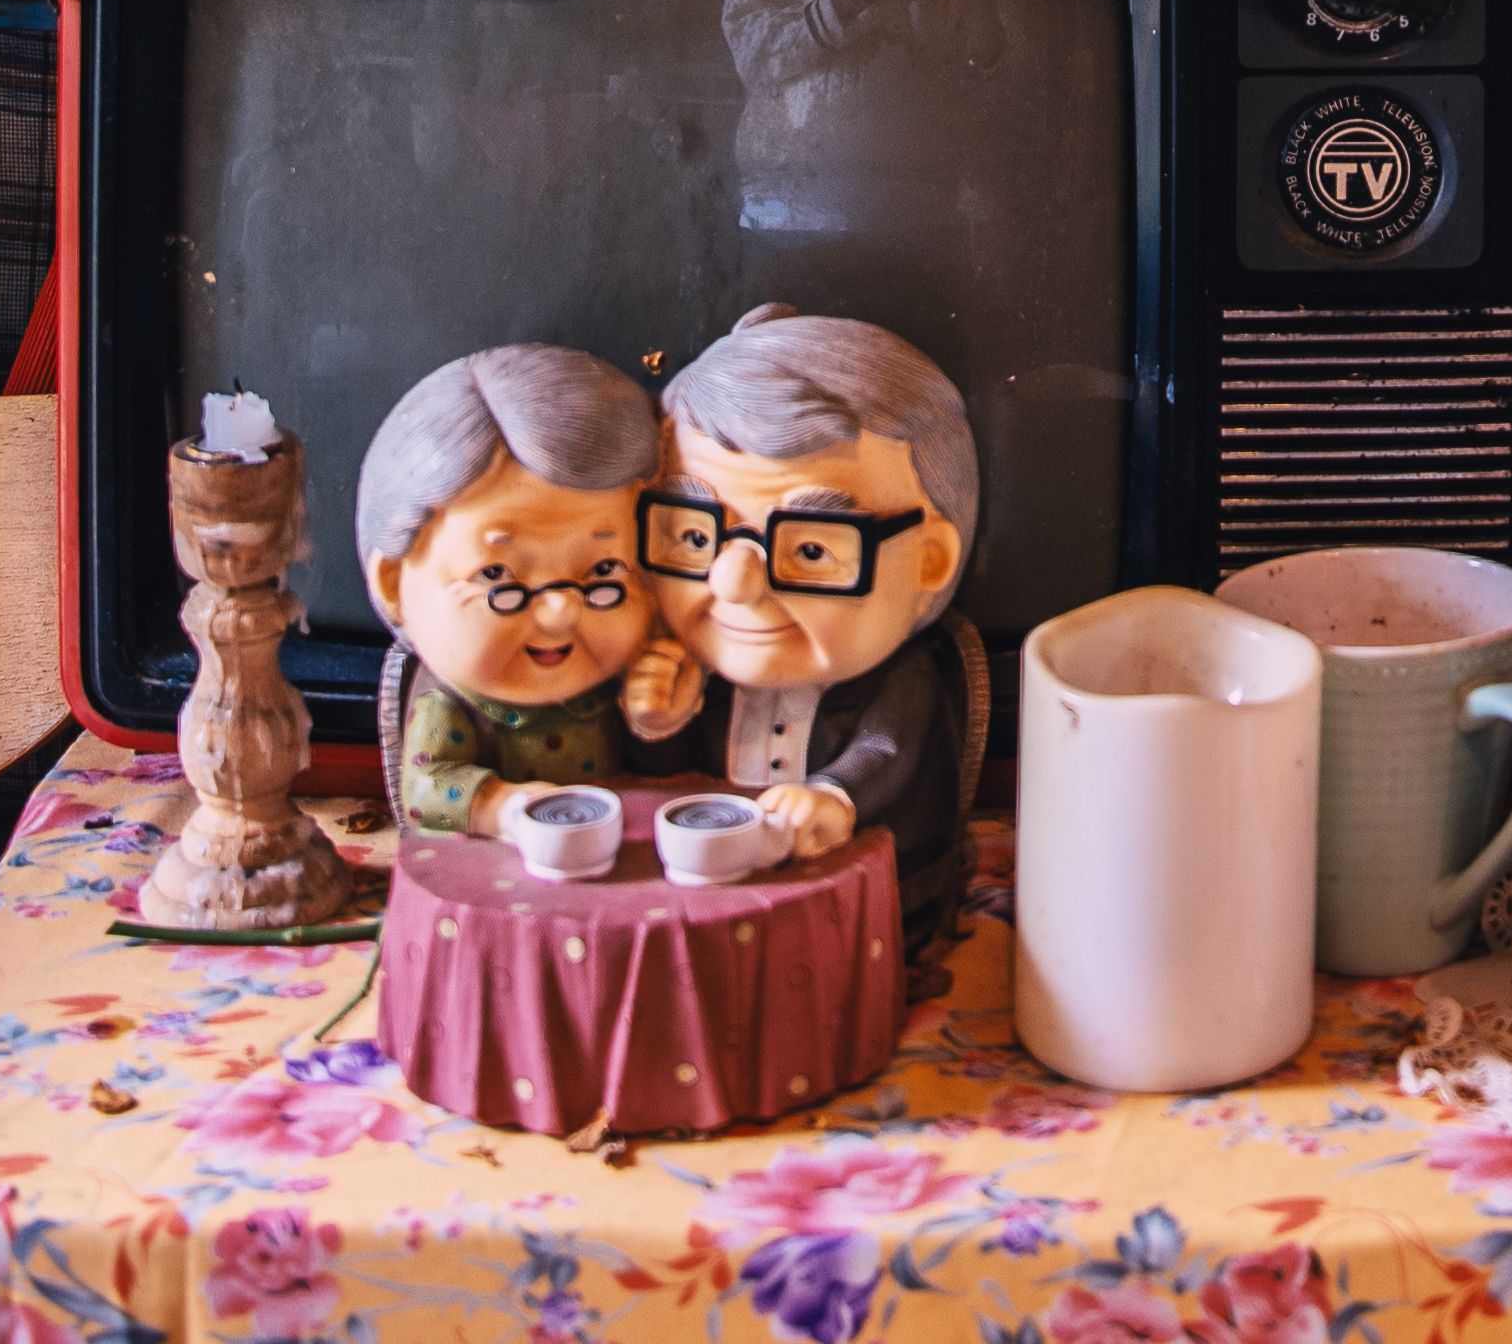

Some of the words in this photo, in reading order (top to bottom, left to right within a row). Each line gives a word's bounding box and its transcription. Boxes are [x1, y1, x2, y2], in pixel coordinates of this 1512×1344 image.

[1306, 13, 1317, 26] 8
[1399, 15, 1409, 28] 5
[1370, 29, 1380, 42] 6
[1285, 120, 1312, 165] BLACK
[1315, 95, 1361, 120] WHITE
[1382, 100, 1436, 168] TELEVISION
[1323, 162, 1393, 201] TV
[1286, 175, 1312, 218] BLACK
[1377, 175, 1434, 243] TELEVISION
